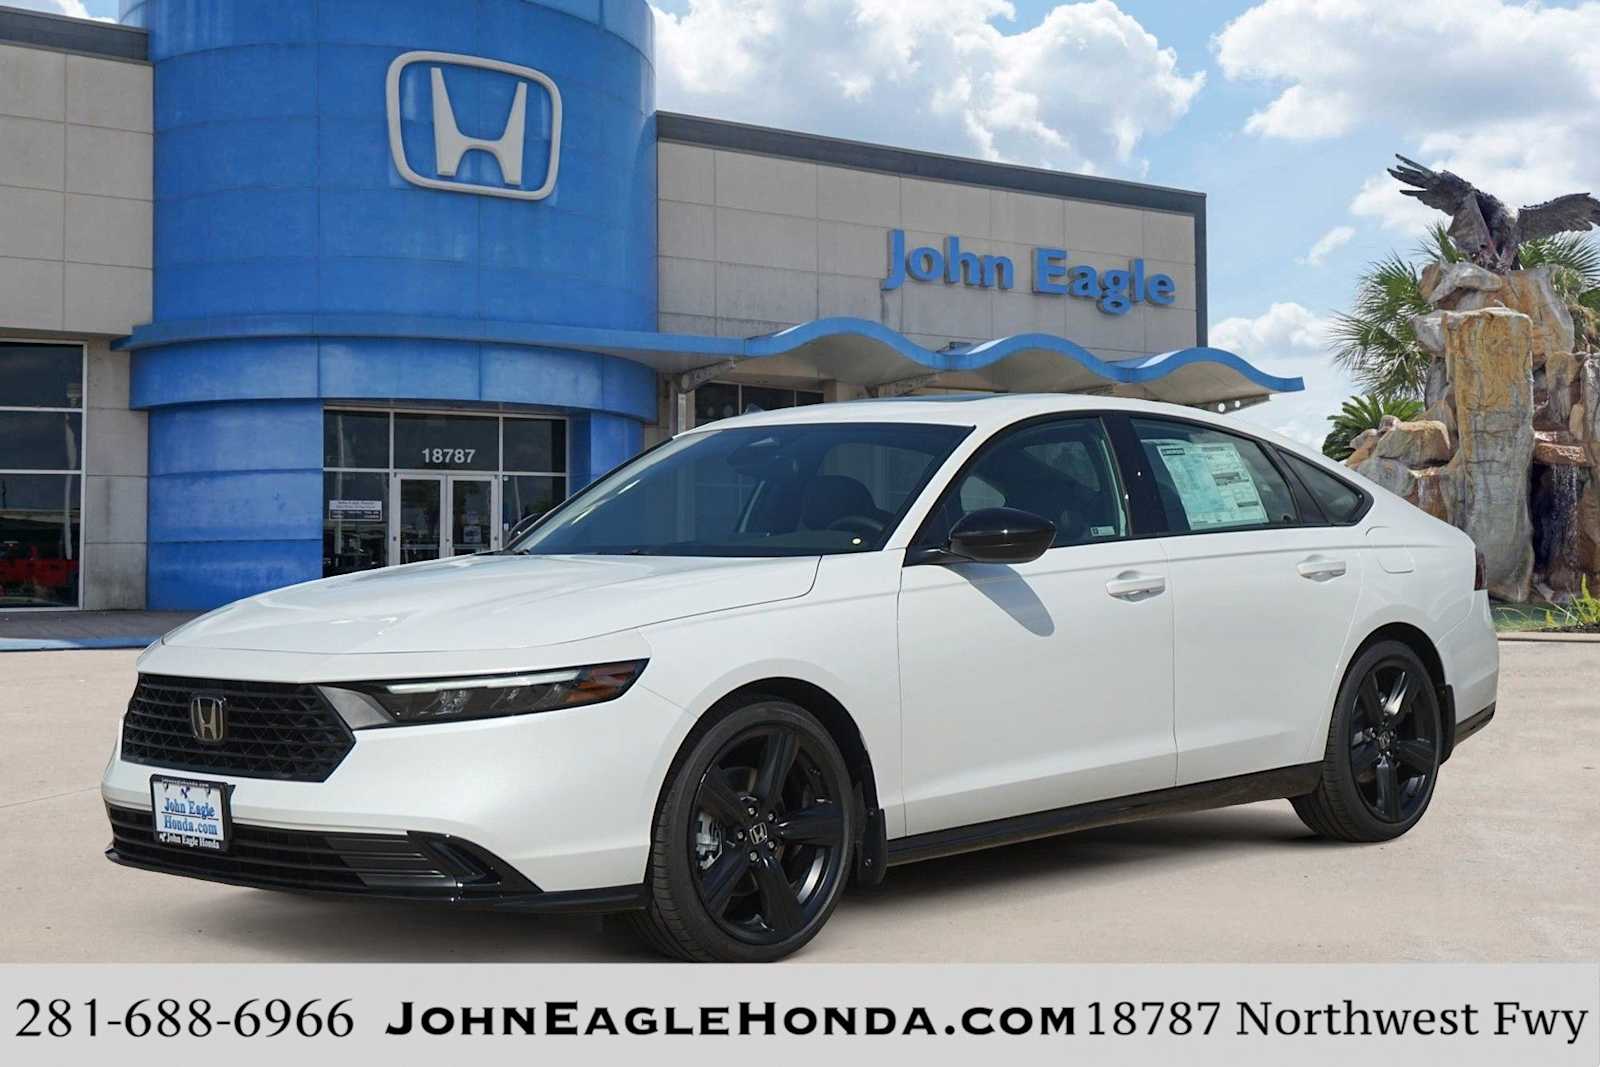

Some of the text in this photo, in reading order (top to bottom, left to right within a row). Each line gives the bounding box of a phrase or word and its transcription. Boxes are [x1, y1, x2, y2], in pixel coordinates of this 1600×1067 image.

[880, 229, 1176, 315] John Eagle
[422, 448, 476, 464] 18787
[164, 797, 215, 819] John Eagle
[164, 815, 218, 835] Honda.com
